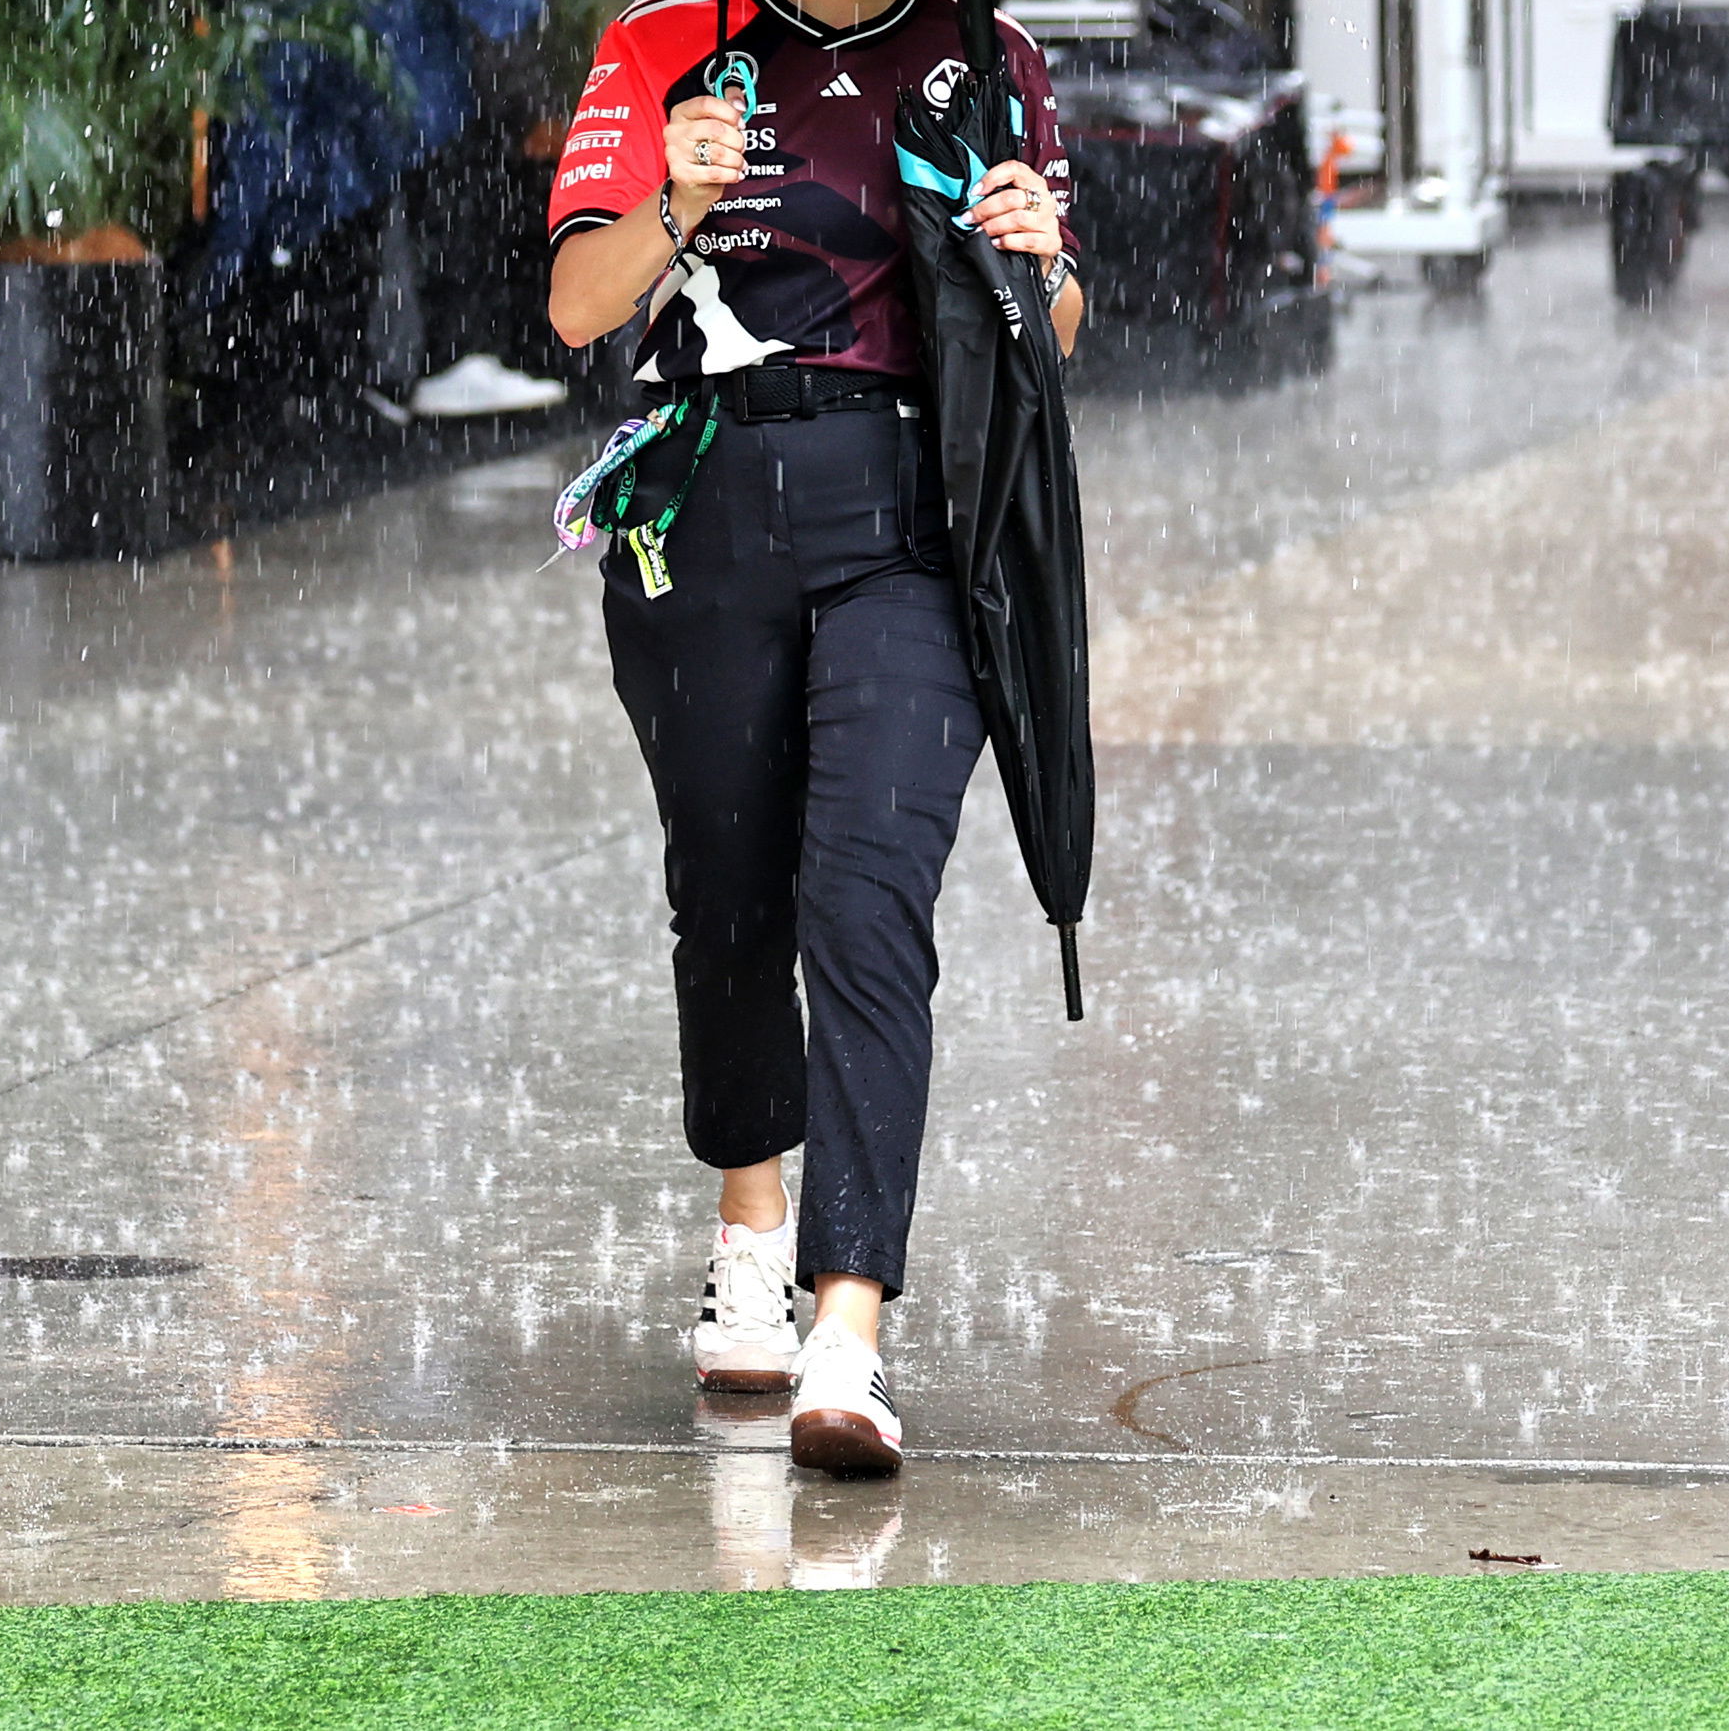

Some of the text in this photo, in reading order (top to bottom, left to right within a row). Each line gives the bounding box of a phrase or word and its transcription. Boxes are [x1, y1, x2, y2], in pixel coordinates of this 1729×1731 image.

[740, 128, 777, 151] BS
[559, 155, 613, 190] nuvei
[1042, 159, 1070, 178] AMD
[708, 196, 782, 213] napdragon
